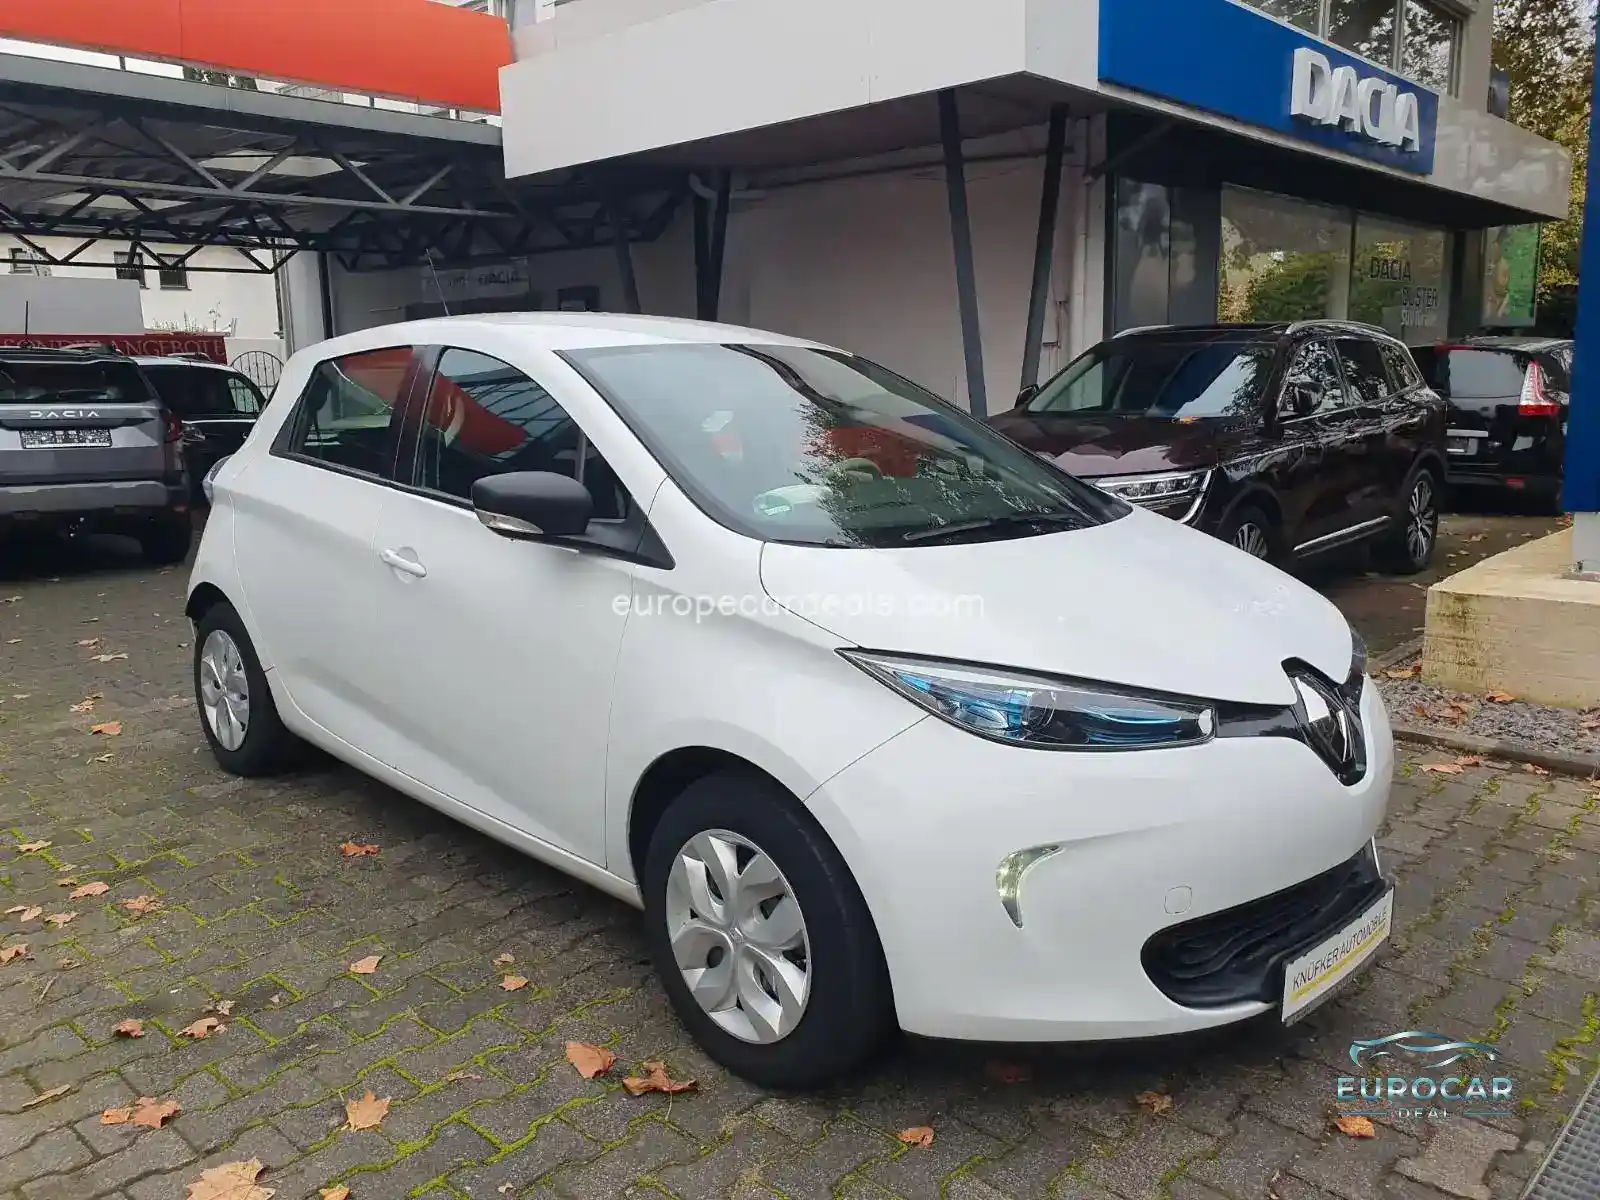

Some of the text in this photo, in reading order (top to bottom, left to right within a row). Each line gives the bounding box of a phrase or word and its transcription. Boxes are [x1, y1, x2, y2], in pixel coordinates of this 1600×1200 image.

[1291, 48, 1419, 152] DACIA
[1370, 256, 1411, 281] DACIA
[29, 410, 100, 418] DACIA
[1293, 906, 1388, 990] KNÜFKER AUTOMOBILE
